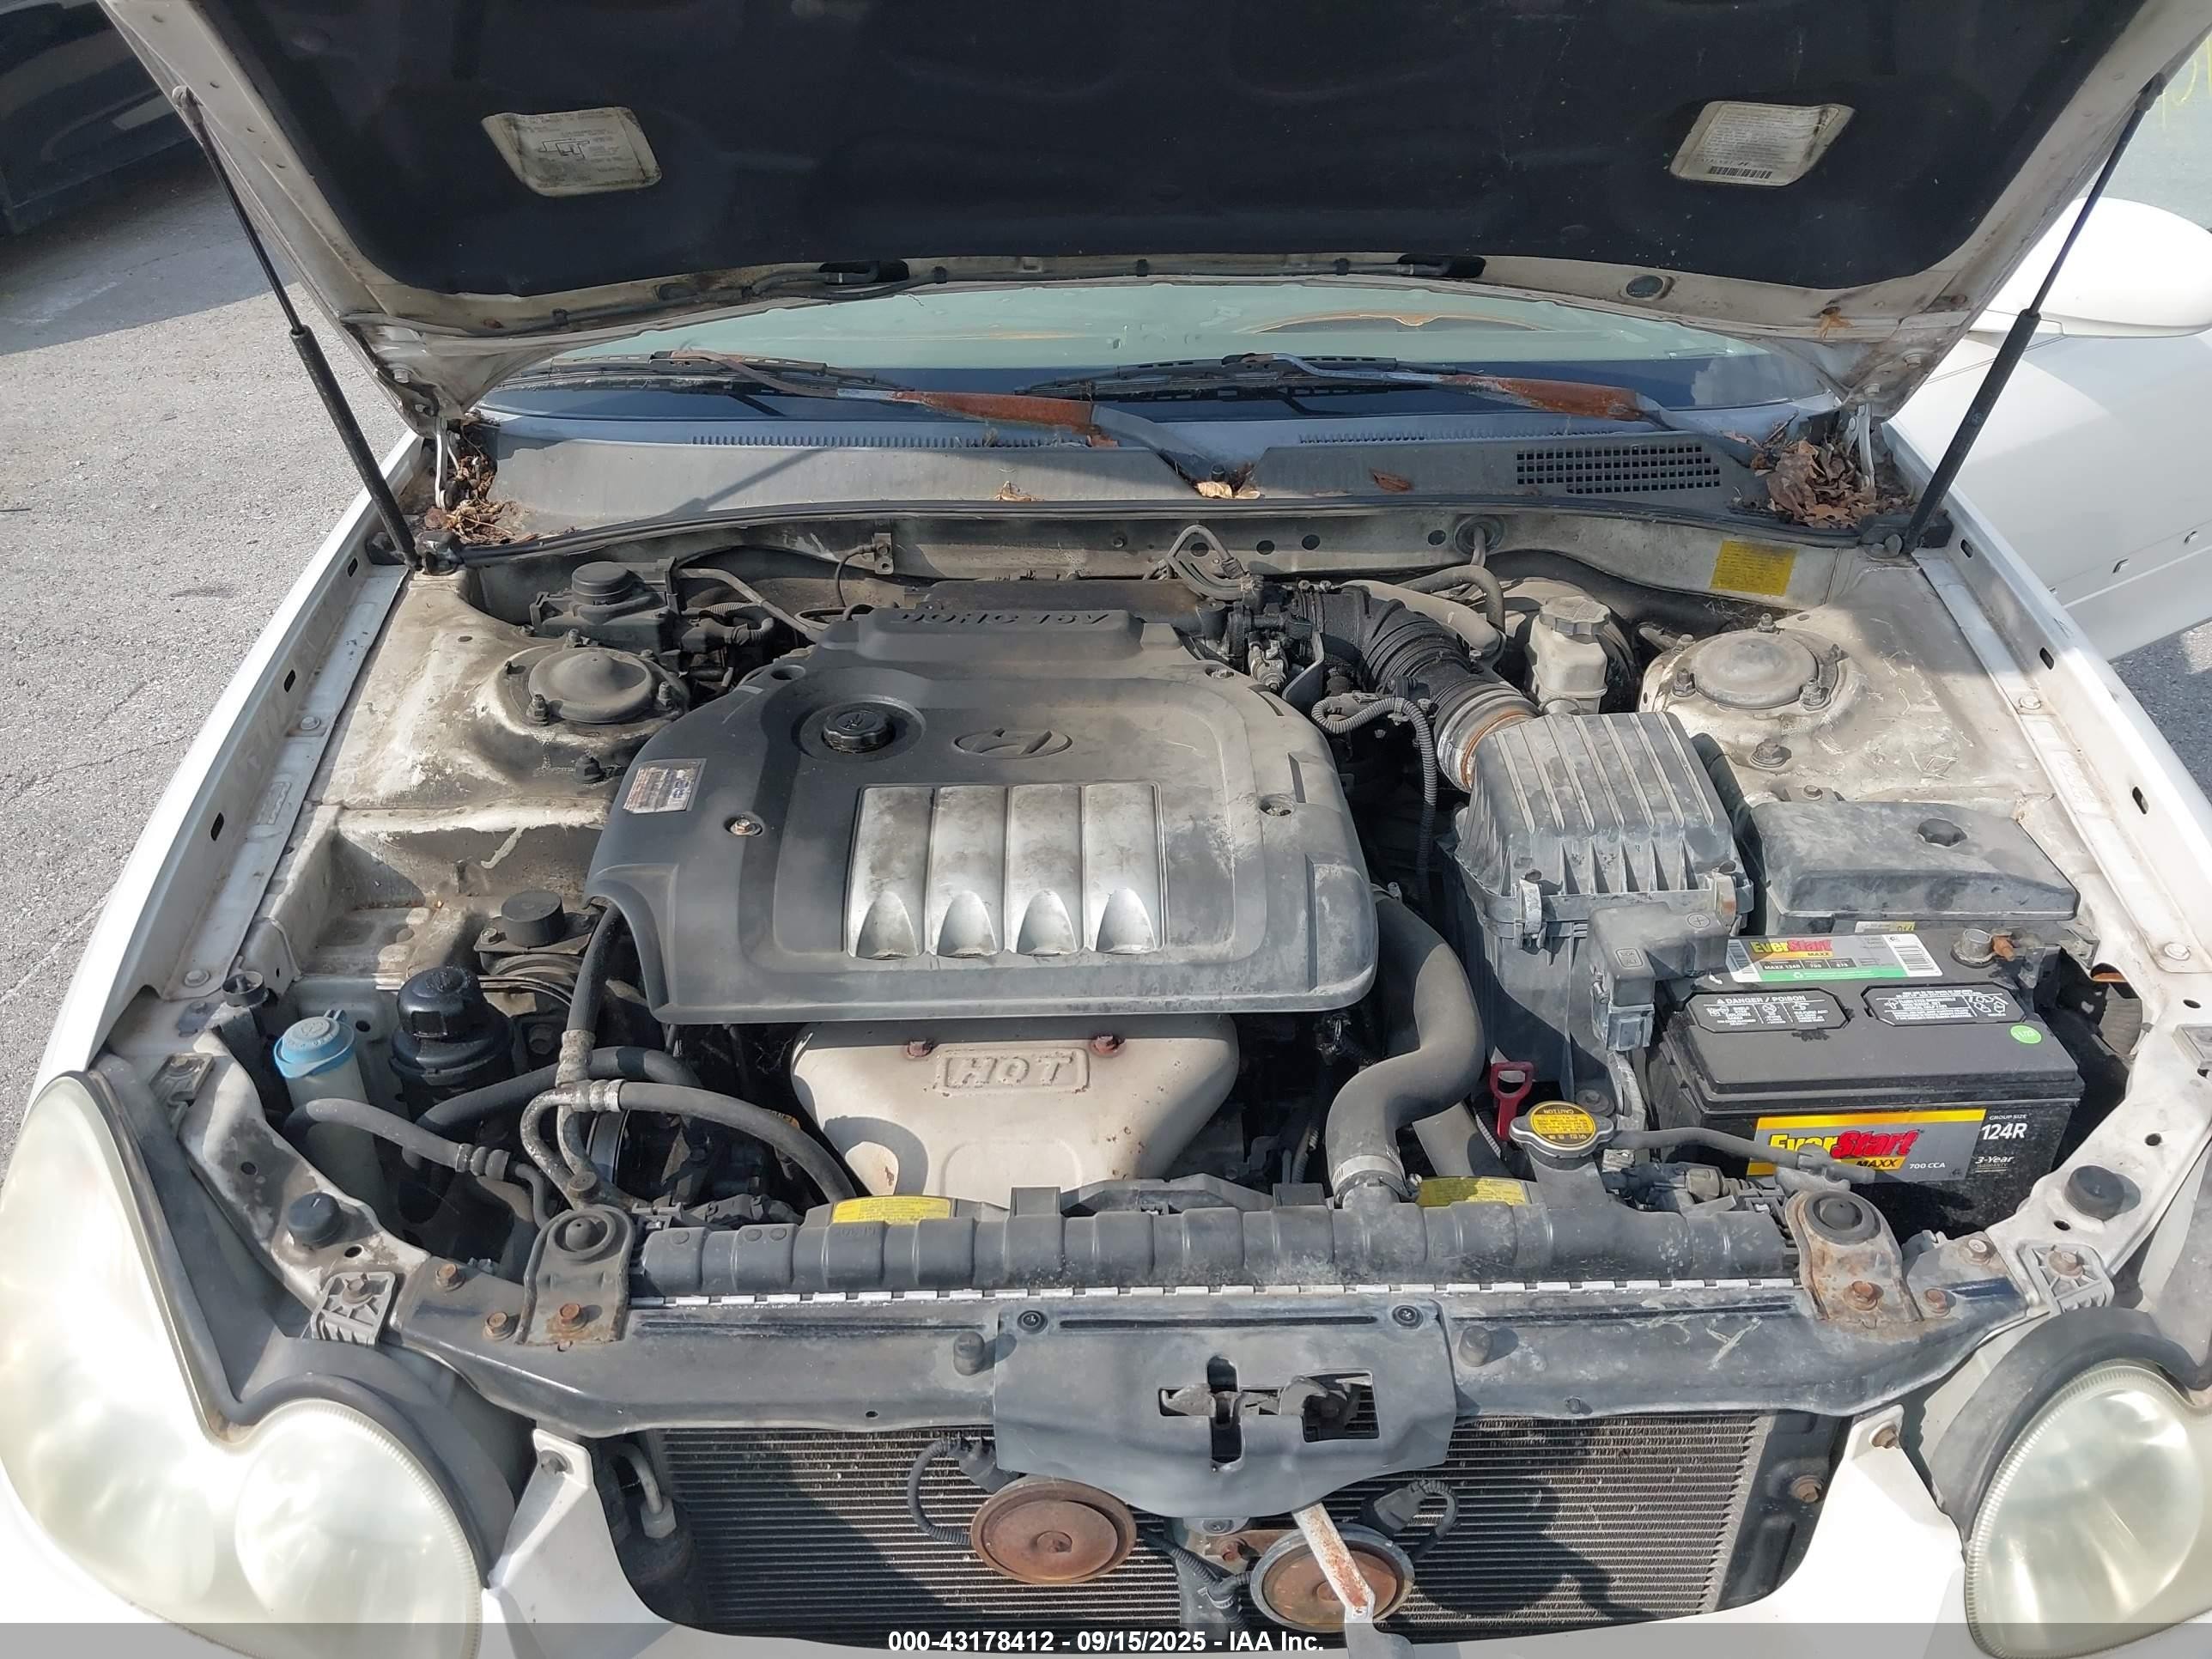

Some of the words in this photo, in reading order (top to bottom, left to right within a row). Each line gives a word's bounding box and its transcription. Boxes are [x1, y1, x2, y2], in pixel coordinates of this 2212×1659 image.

[1750, 939, 1833, 954] EverStart
[950, 1056, 1073, 1086] HOT
[1981, 1122, 2028, 1140] 124R
[1975, 1155, 2014, 1164] 3-Year
